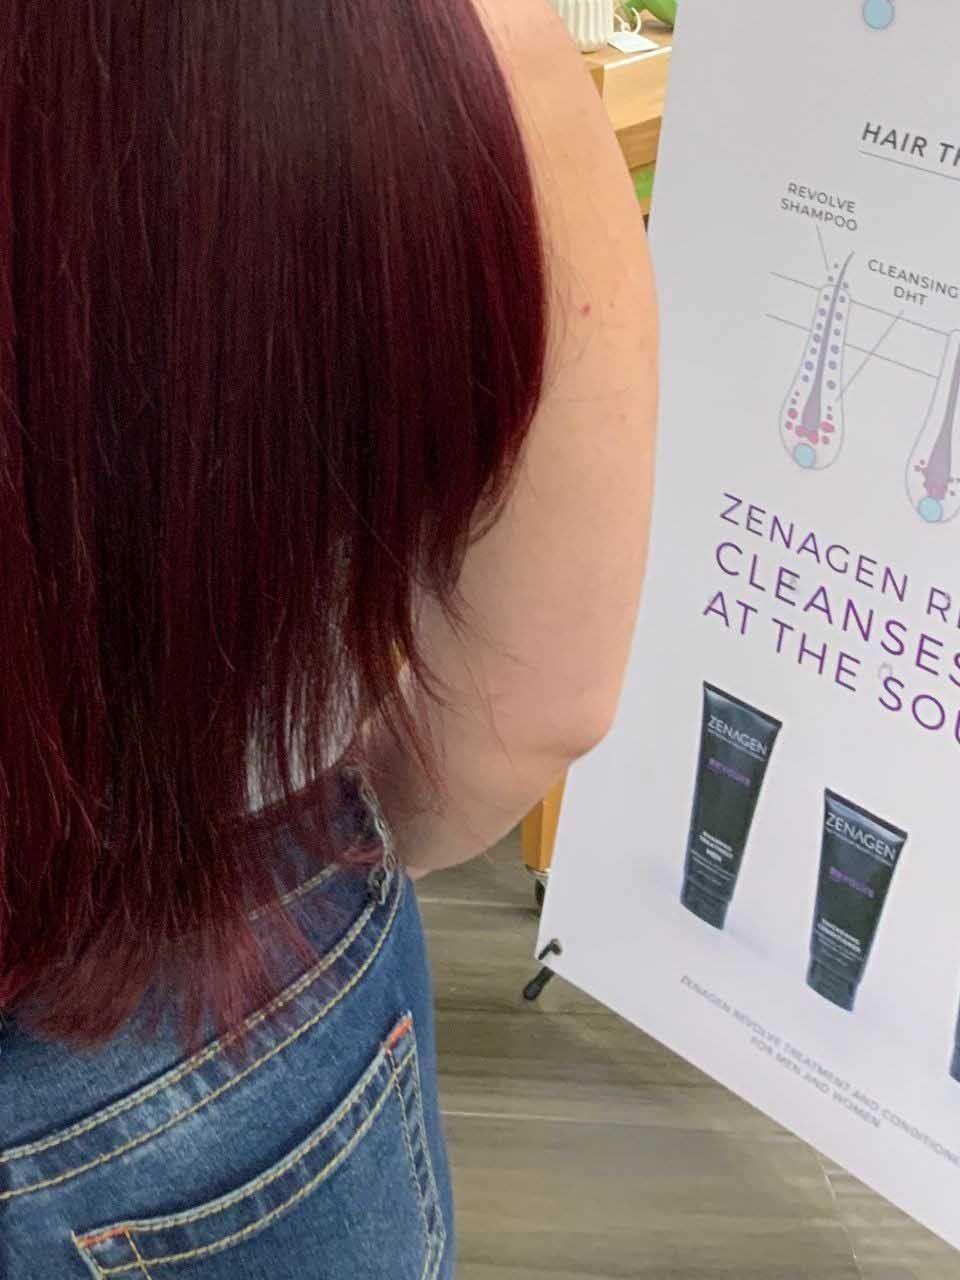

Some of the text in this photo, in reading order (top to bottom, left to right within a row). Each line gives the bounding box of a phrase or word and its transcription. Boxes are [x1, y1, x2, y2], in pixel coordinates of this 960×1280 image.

[862, 122, 928, 157] HAIR
[780, 197, 858, 232] SHAMPOO
[788, 182, 856, 214] REVOLVE
[867, 259, 959, 299] CLEANSING
[893, 285, 928, 306] DHT
[720, 492, 908, 602] ZENAGEN
[703, 591, 758, 635] AT
[771, 617, 861, 692] THE
[707, 716, 768, 756] ZENAGEN
[825, 812, 897, 861] ZENAGEN
[732, 1009, 782, 1046] REVOLVE
[784, 1042, 852, 1091] TREATMENT
[852, 1089, 880, 1112] AND
[751, 1036, 881, 1128] FOR MEN AND WOMEN
